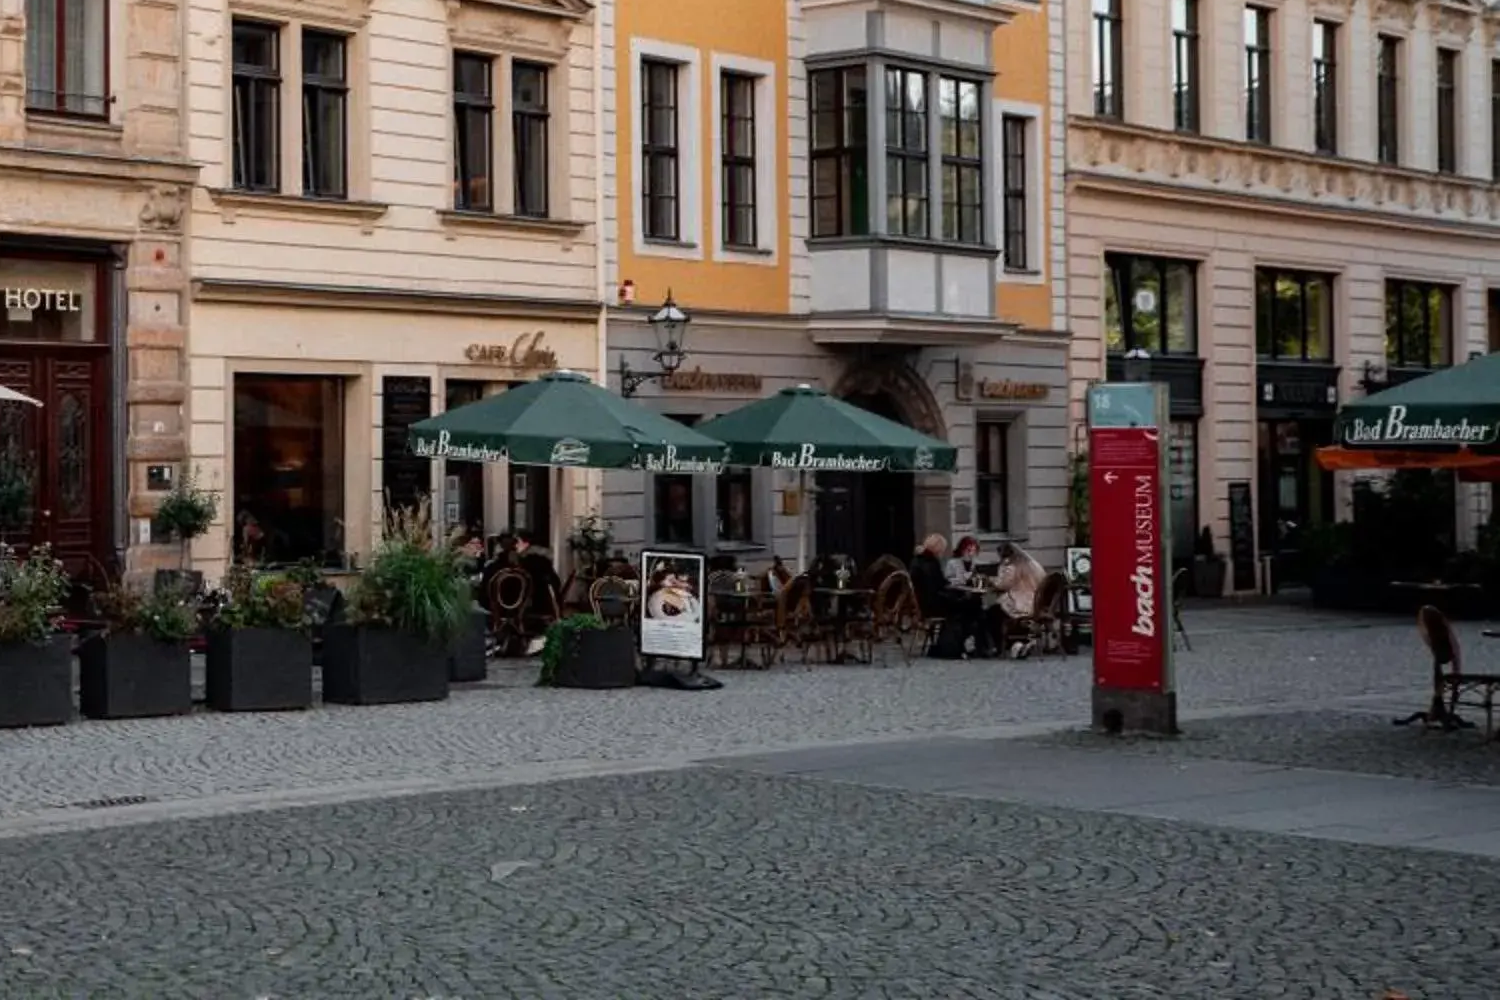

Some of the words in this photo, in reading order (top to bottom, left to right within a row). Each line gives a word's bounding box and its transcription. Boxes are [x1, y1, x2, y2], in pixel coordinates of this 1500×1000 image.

[5, 287, 80, 311] HOTEL
[1353, 417, 1383, 441] Bad
[1385, 405, 1490, 441] Brambacher
[772, 451, 797, 468] Bad
[799, 443, 881, 470] Brambacher
